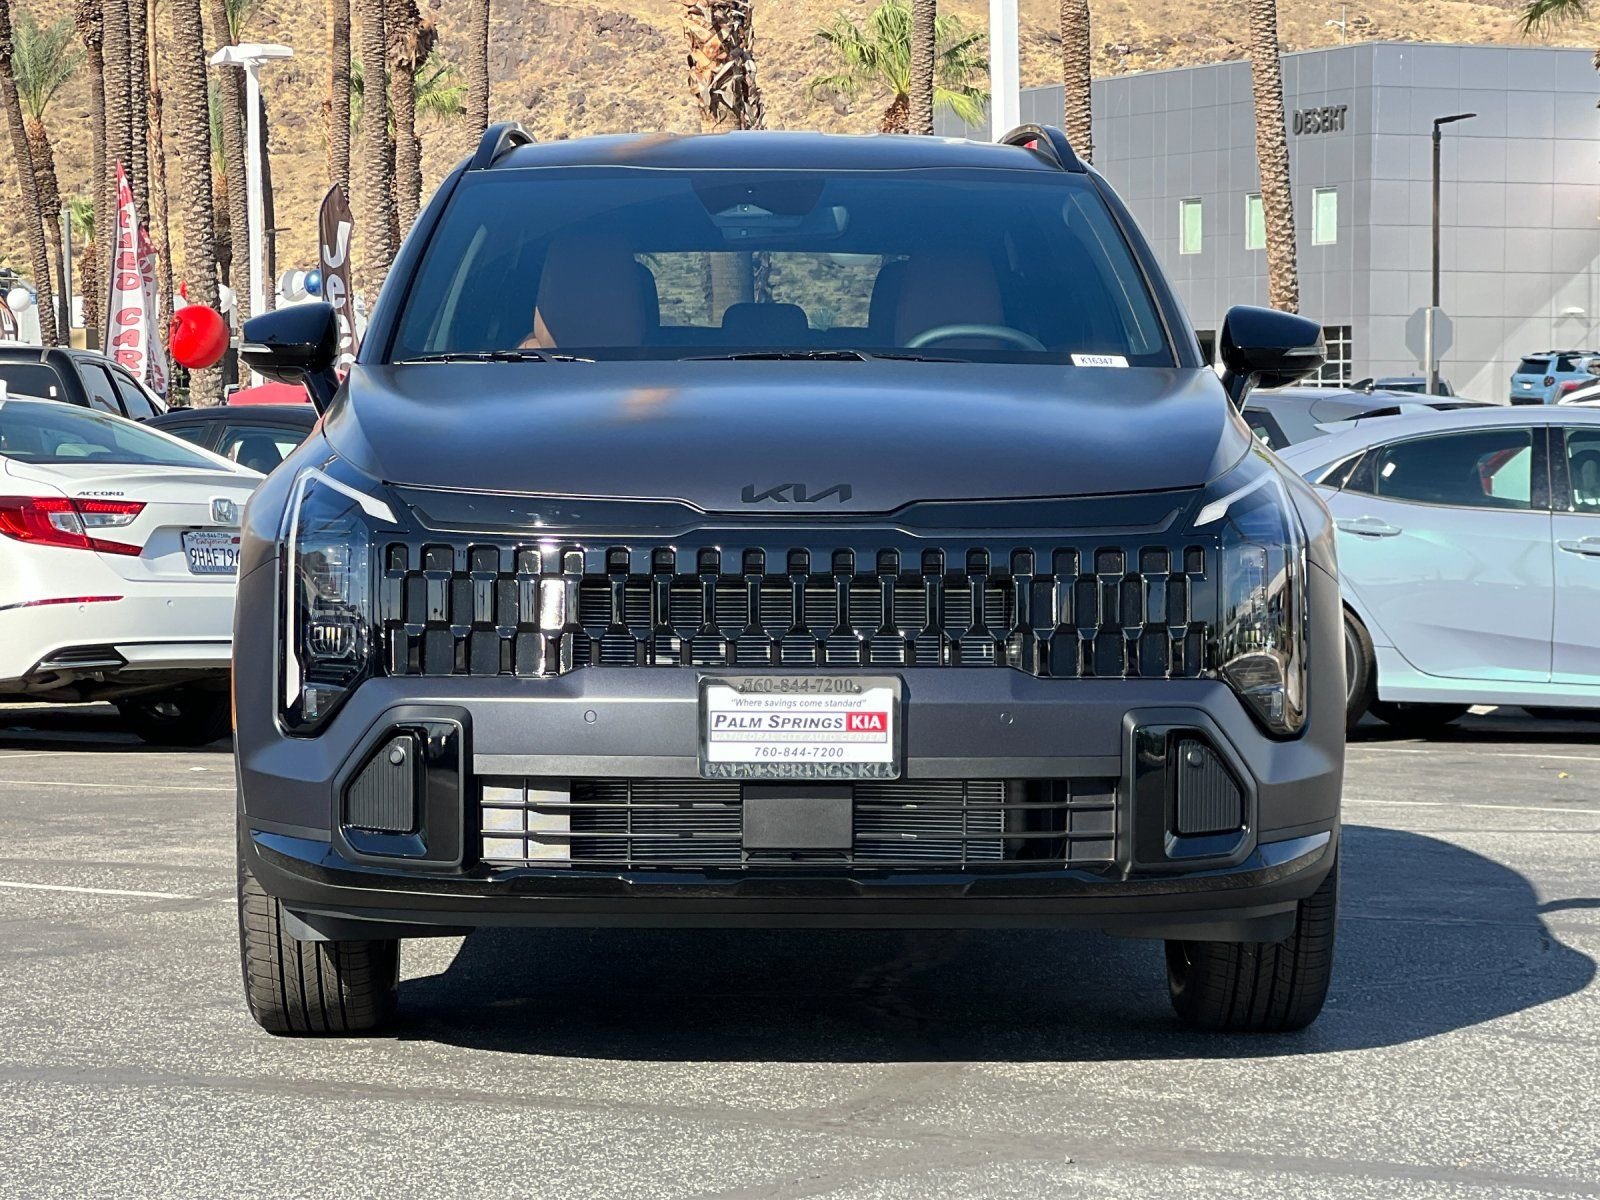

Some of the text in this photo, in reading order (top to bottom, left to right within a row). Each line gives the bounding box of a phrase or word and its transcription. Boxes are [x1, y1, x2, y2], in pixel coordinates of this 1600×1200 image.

[1292, 105, 1348, 136] DESERT
[1080, 356, 1113, 365] K16347
[741, 483, 852, 503] KIA
[743, 678, 854, 693] 760-844-7200
[764, 699, 797, 709] savings
[714, 714, 882, 730] PALM SPRINGS KIA
[754, 747, 844, 758] 760-844-7200
[858, 763, 896, 778] KIA
